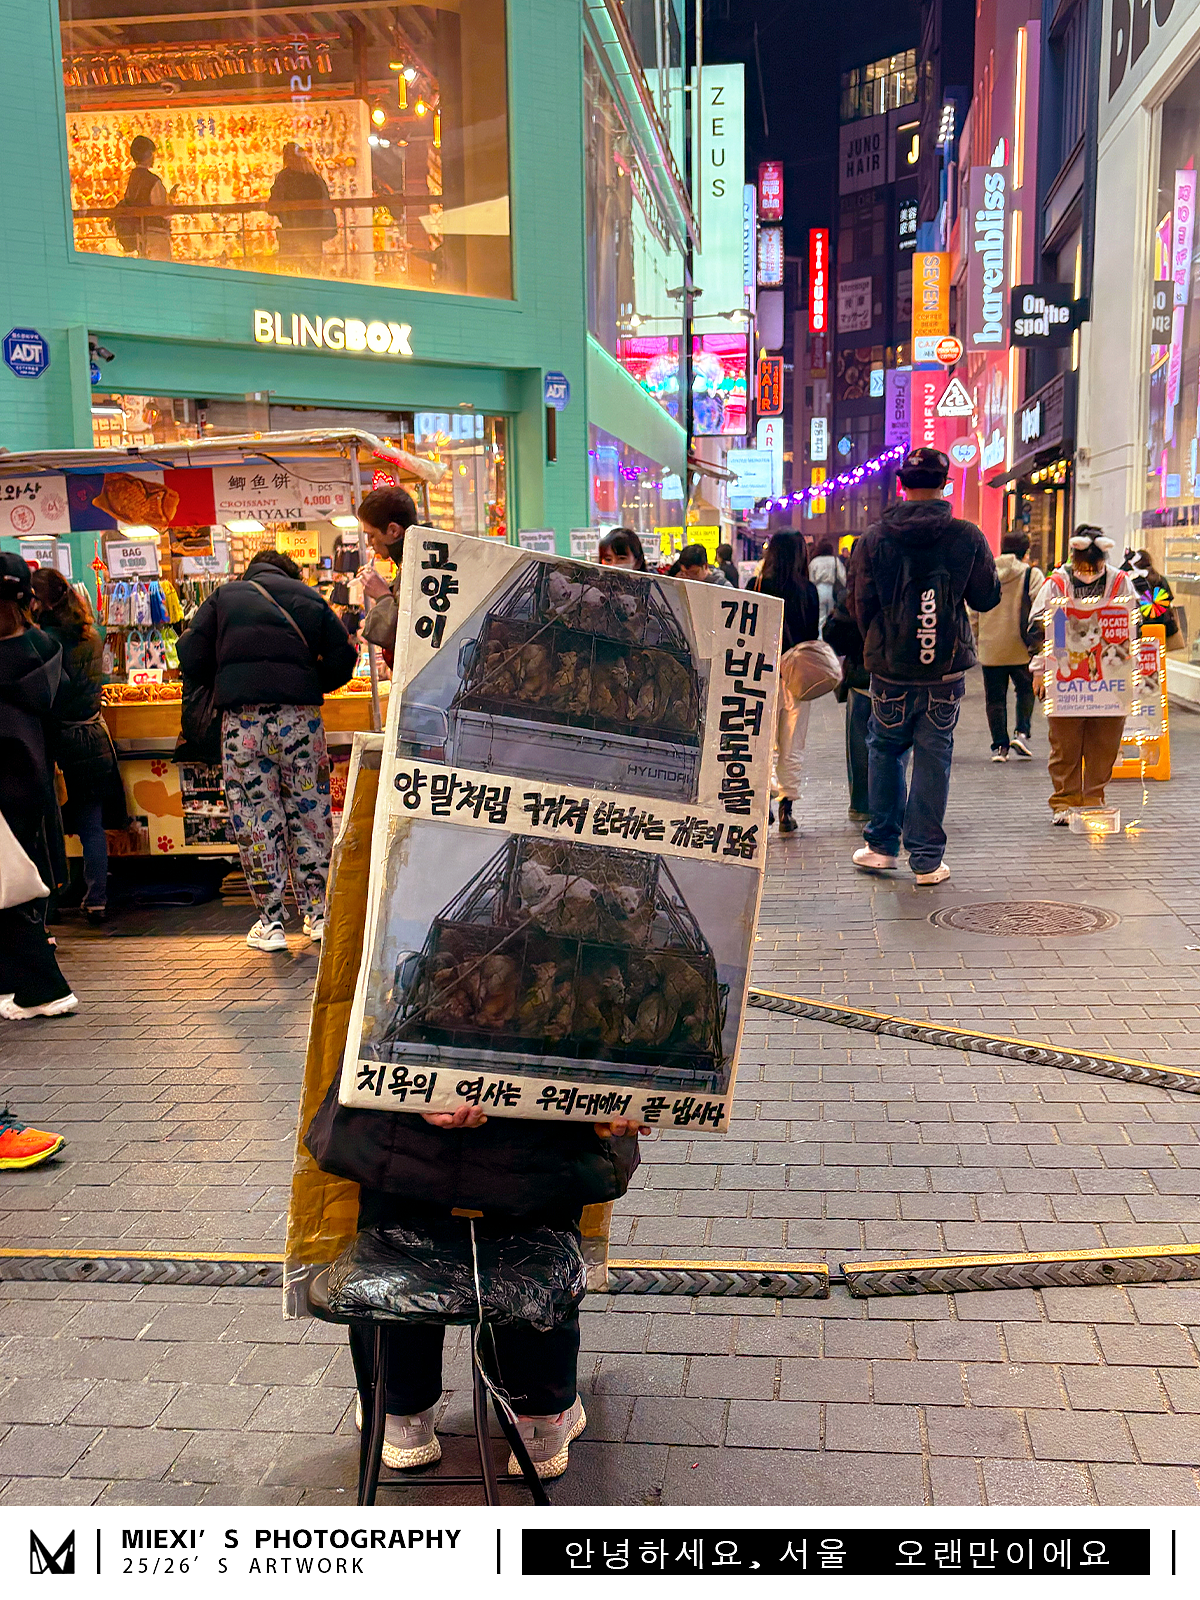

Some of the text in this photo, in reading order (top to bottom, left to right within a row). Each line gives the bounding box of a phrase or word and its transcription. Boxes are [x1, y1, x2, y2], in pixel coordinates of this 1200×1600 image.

[711, 86, 726, 198] ZEUS
[847, 133, 880, 159] JUNO
[846, 154, 880, 178] HAIR
[973, 172, 1006, 345] barenbliss
[923, 256, 940, 311] SEVEN
[1023, 295, 1046, 315] On
[254, 309, 413, 355] BLINGBOX
[10, 343, 43, 363] ADT
[546, 384, 567, 399] ADT
[761, 361, 772, 411] HAIR
[227, 473, 292, 491] 鲫鱼饼
[317, 483, 334, 491] pcs
[219, 498, 279, 508] CROISSANT
[303, 494, 331, 506] 4,000
[233, 508, 304, 520] TAIYAKI
[294, 537, 308, 546] pcs
[122, 548, 142, 557] BAG
[415, 541, 459, 648] 고양이
[916, 588, 937, 665] adidas
[1108, 617, 1129, 628] CATS
[1056, 679, 1126, 692] CAT CAFE
[394, 768, 512, 825] 양말처럼
[356, 1064, 438, 1103] 치욕의
[455, 1076, 522, 1108] 역사는
